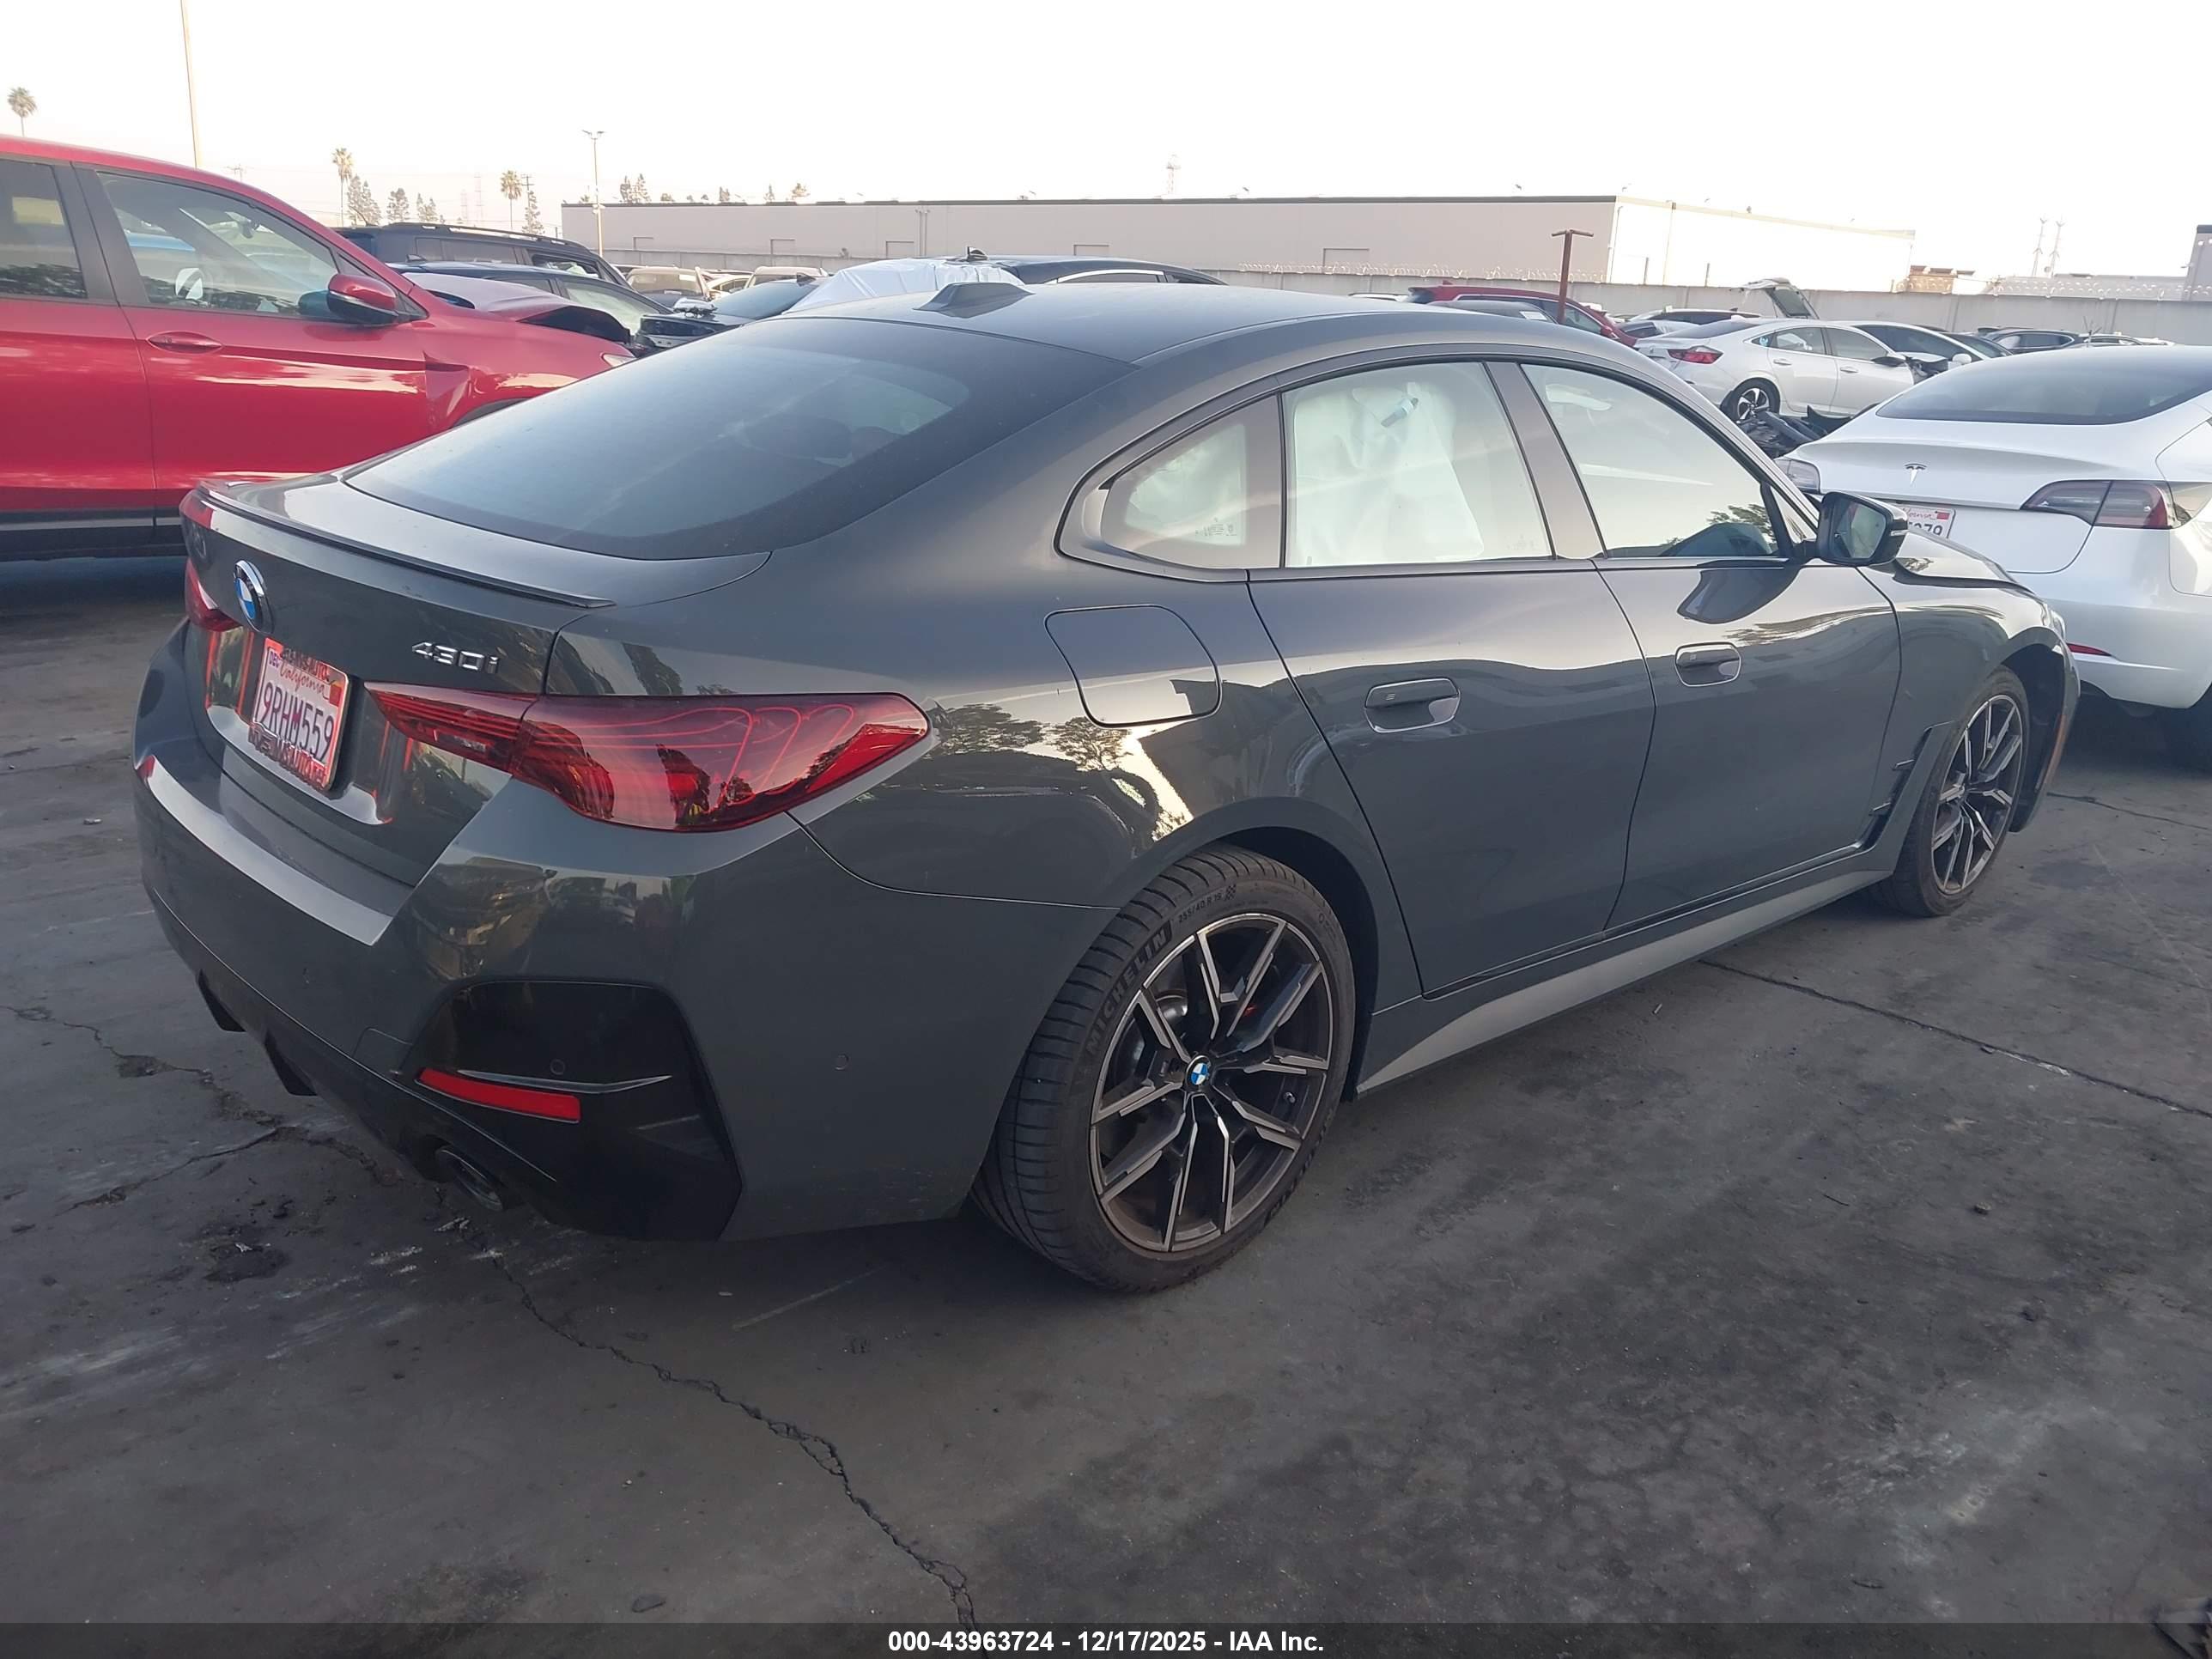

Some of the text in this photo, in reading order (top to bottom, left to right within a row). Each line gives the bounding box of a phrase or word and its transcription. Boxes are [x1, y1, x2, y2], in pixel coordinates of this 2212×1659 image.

[280, 664, 330, 700] California
[412, 641, 498, 673] 430i
[260, 682, 334, 761] 9RHM559
[1085, 927, 1169, 1055] MICHELIN
